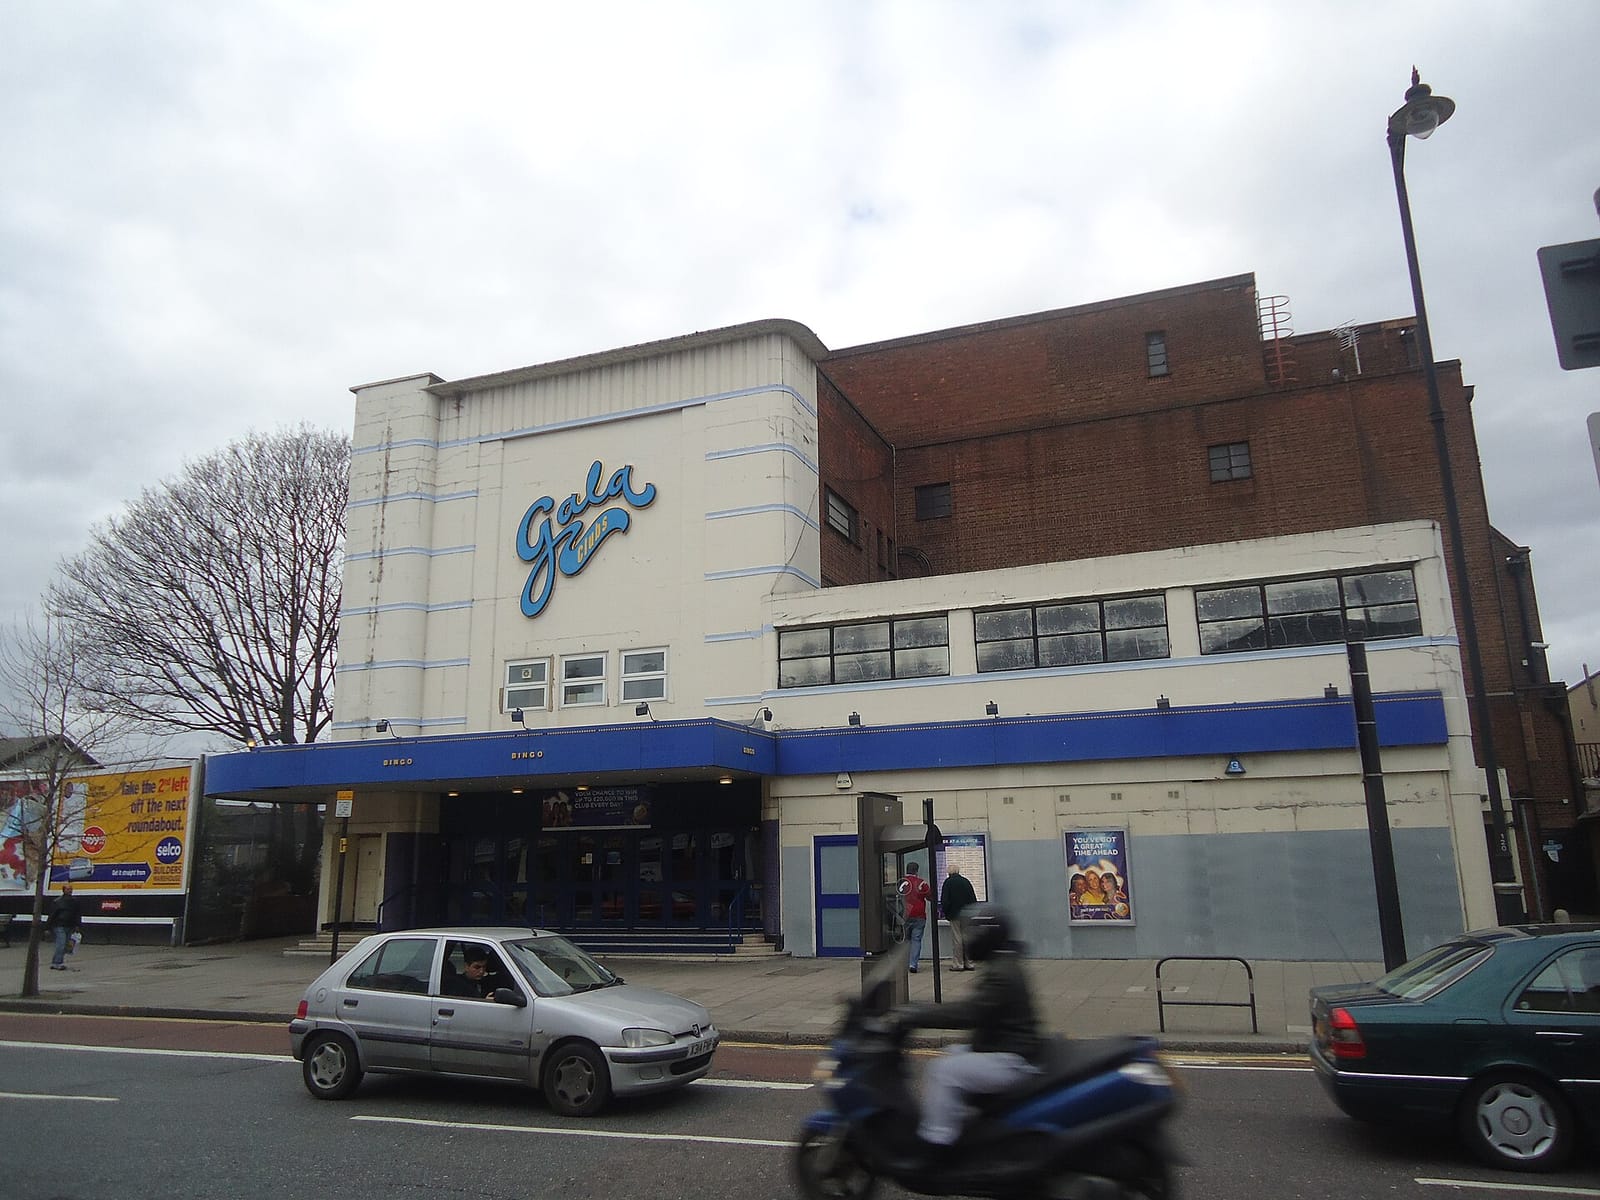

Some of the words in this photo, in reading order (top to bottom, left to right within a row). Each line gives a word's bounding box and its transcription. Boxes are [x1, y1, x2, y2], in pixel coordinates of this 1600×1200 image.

[382, 758, 414, 767] BINGO
[511, 751, 544, 760] BINGO
[142, 780, 156, 793] the
[158, 778, 171, 792] 2nd
[171, 776, 188, 792] left
[131, 798, 144, 813] off
[147, 798, 162, 812] the
[165, 796, 187, 811] next
[127, 816, 184, 832] roundabout.
[156, 842, 181, 856] selco
[153, 865, 182, 874] BUILDERS
